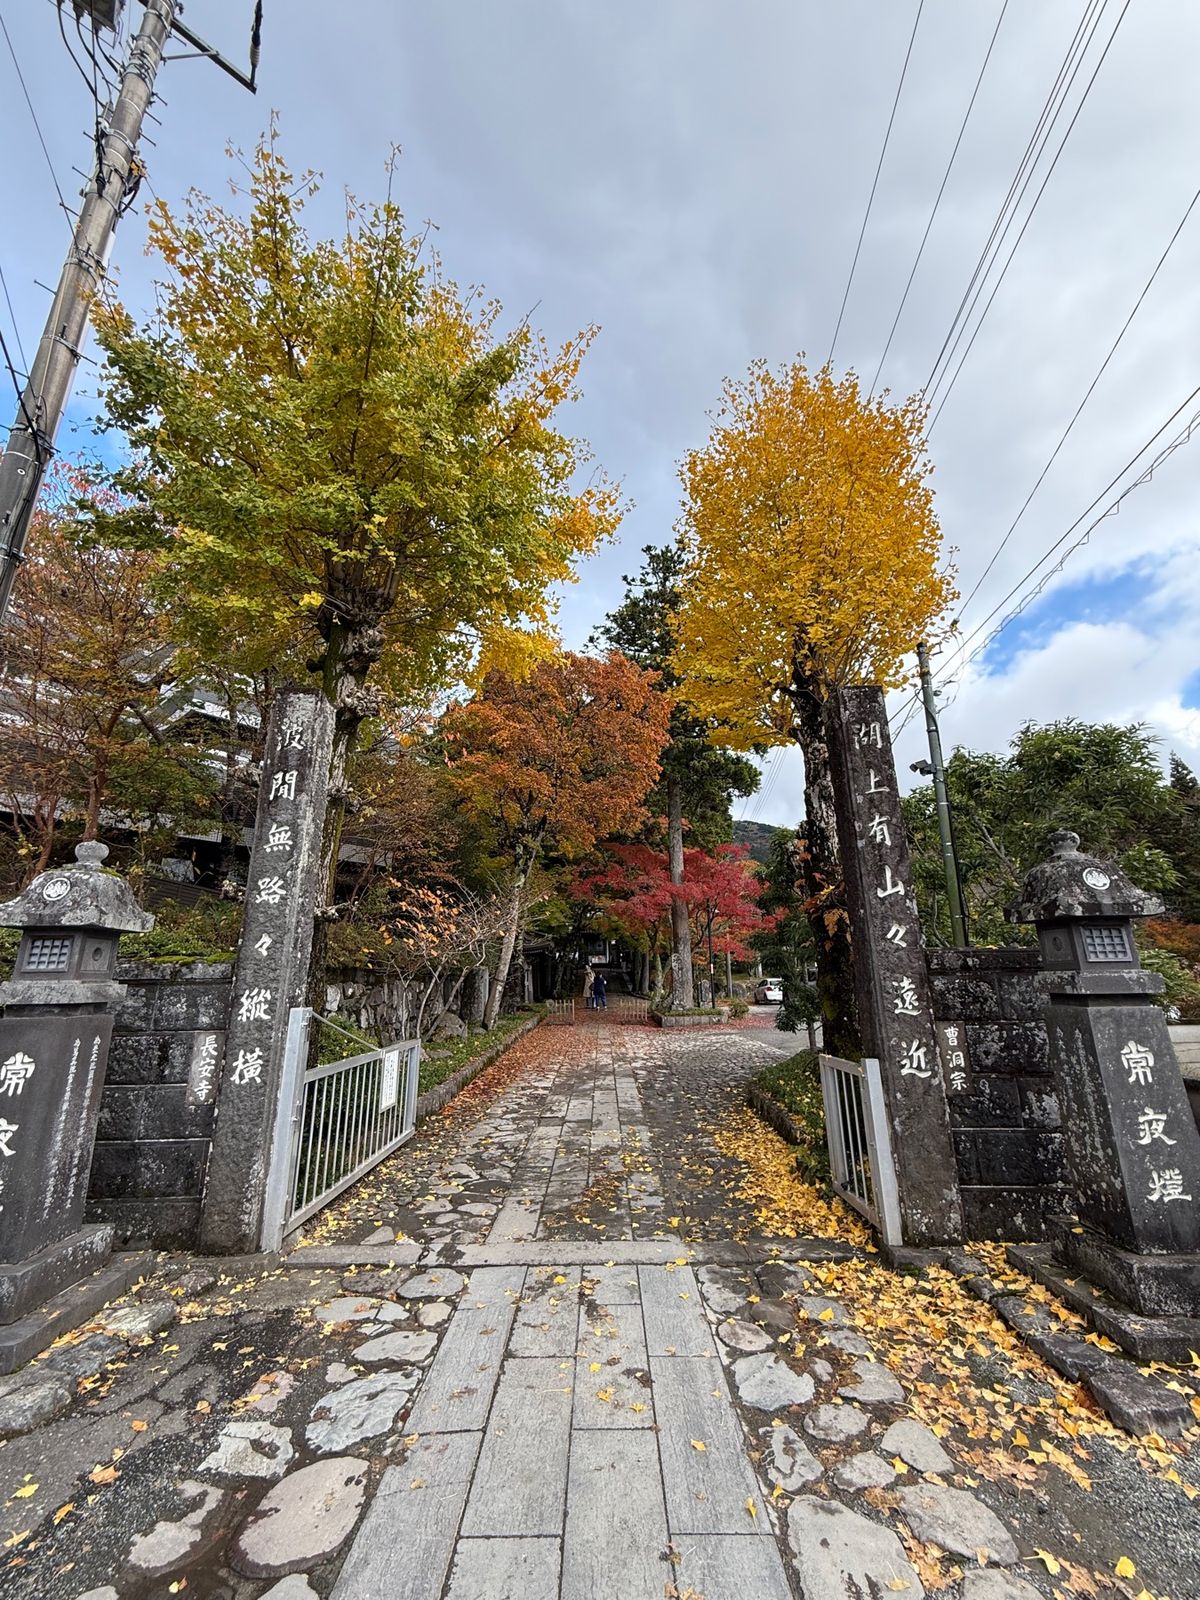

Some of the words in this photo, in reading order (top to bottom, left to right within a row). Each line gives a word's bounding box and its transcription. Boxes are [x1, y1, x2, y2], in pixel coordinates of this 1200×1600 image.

[851, 721, 932, 1079] 湖上有山々遠近
[194, 1034, 218, 1101] 長安寺
[944, 1025, 967, 1091] 曹洞宗
[1120, 1040, 1193, 1203] 常夜燈
